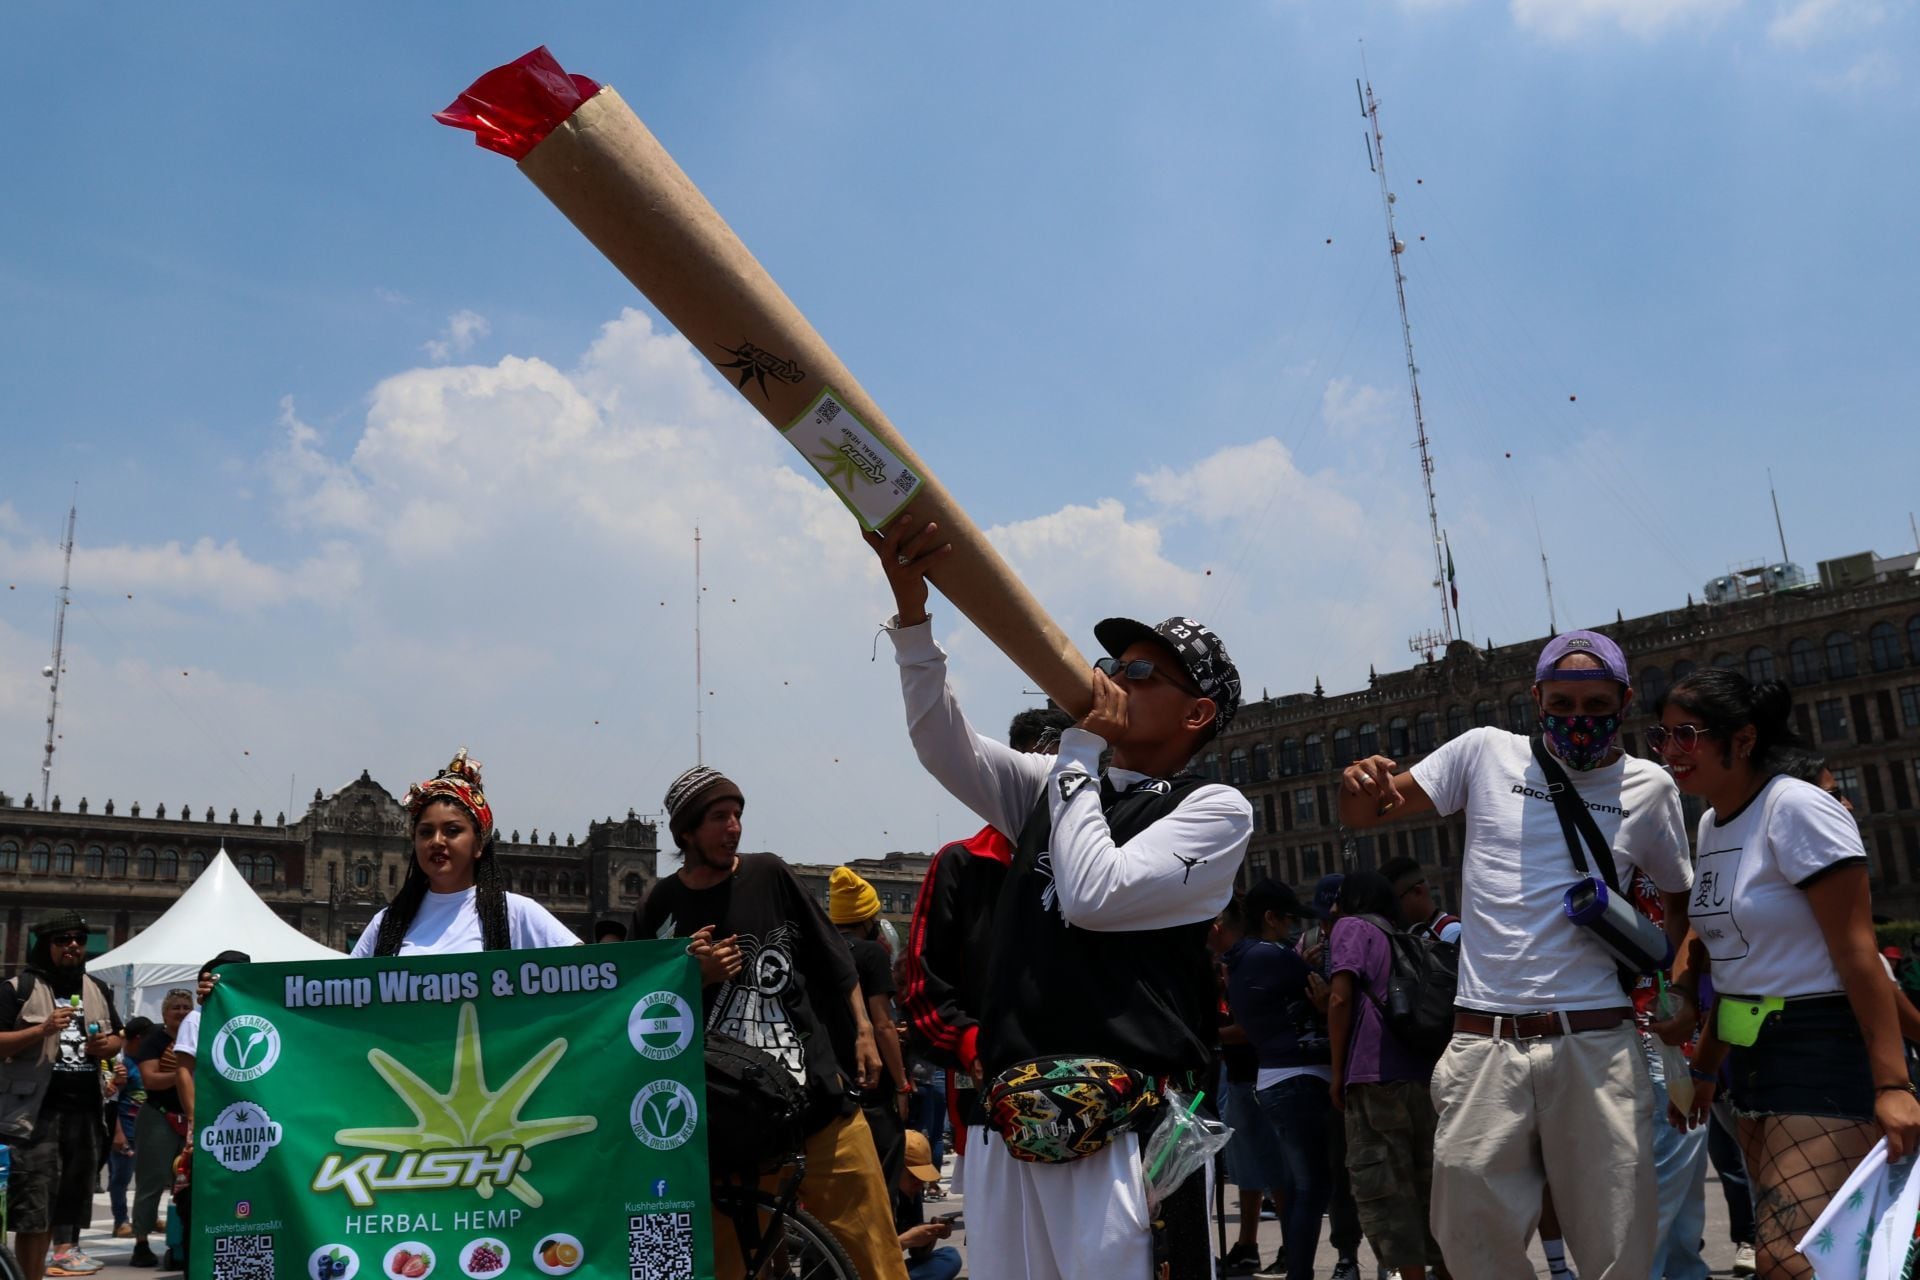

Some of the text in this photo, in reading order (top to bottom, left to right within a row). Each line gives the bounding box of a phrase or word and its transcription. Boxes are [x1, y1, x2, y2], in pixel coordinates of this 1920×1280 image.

[840, 427, 887, 468] HERBAL HEMP
[840, 444, 886, 484] KUSH
[1170, 624, 1192, 639] 23
[285, 962, 618, 1008] Hemp Wraps & Cones
[642, 992, 677, 1007] TABACO
[222, 1016, 274, 1036] VEGETARIAN
[654, 1020, 668, 1031] SIN
[640, 1043, 682, 1059] NICOTINA
[223, 1065, 263, 1081] FRIENDLY
[647, 1081, 678, 1094] VEGAN
[205, 1126, 276, 1146] CANADIAN
[632, 1117, 697, 1149] 100% ORGANIC HEMP
[1011, 1113, 1093, 1141] JORDAN
[223, 1144, 260, 1162] HEMP
[312, 1145, 524, 1207] KUSH
[624, 1200, 696, 1212] Kushherbalwraps
[345, 1208, 521, 1235] HERBAL HEMP
